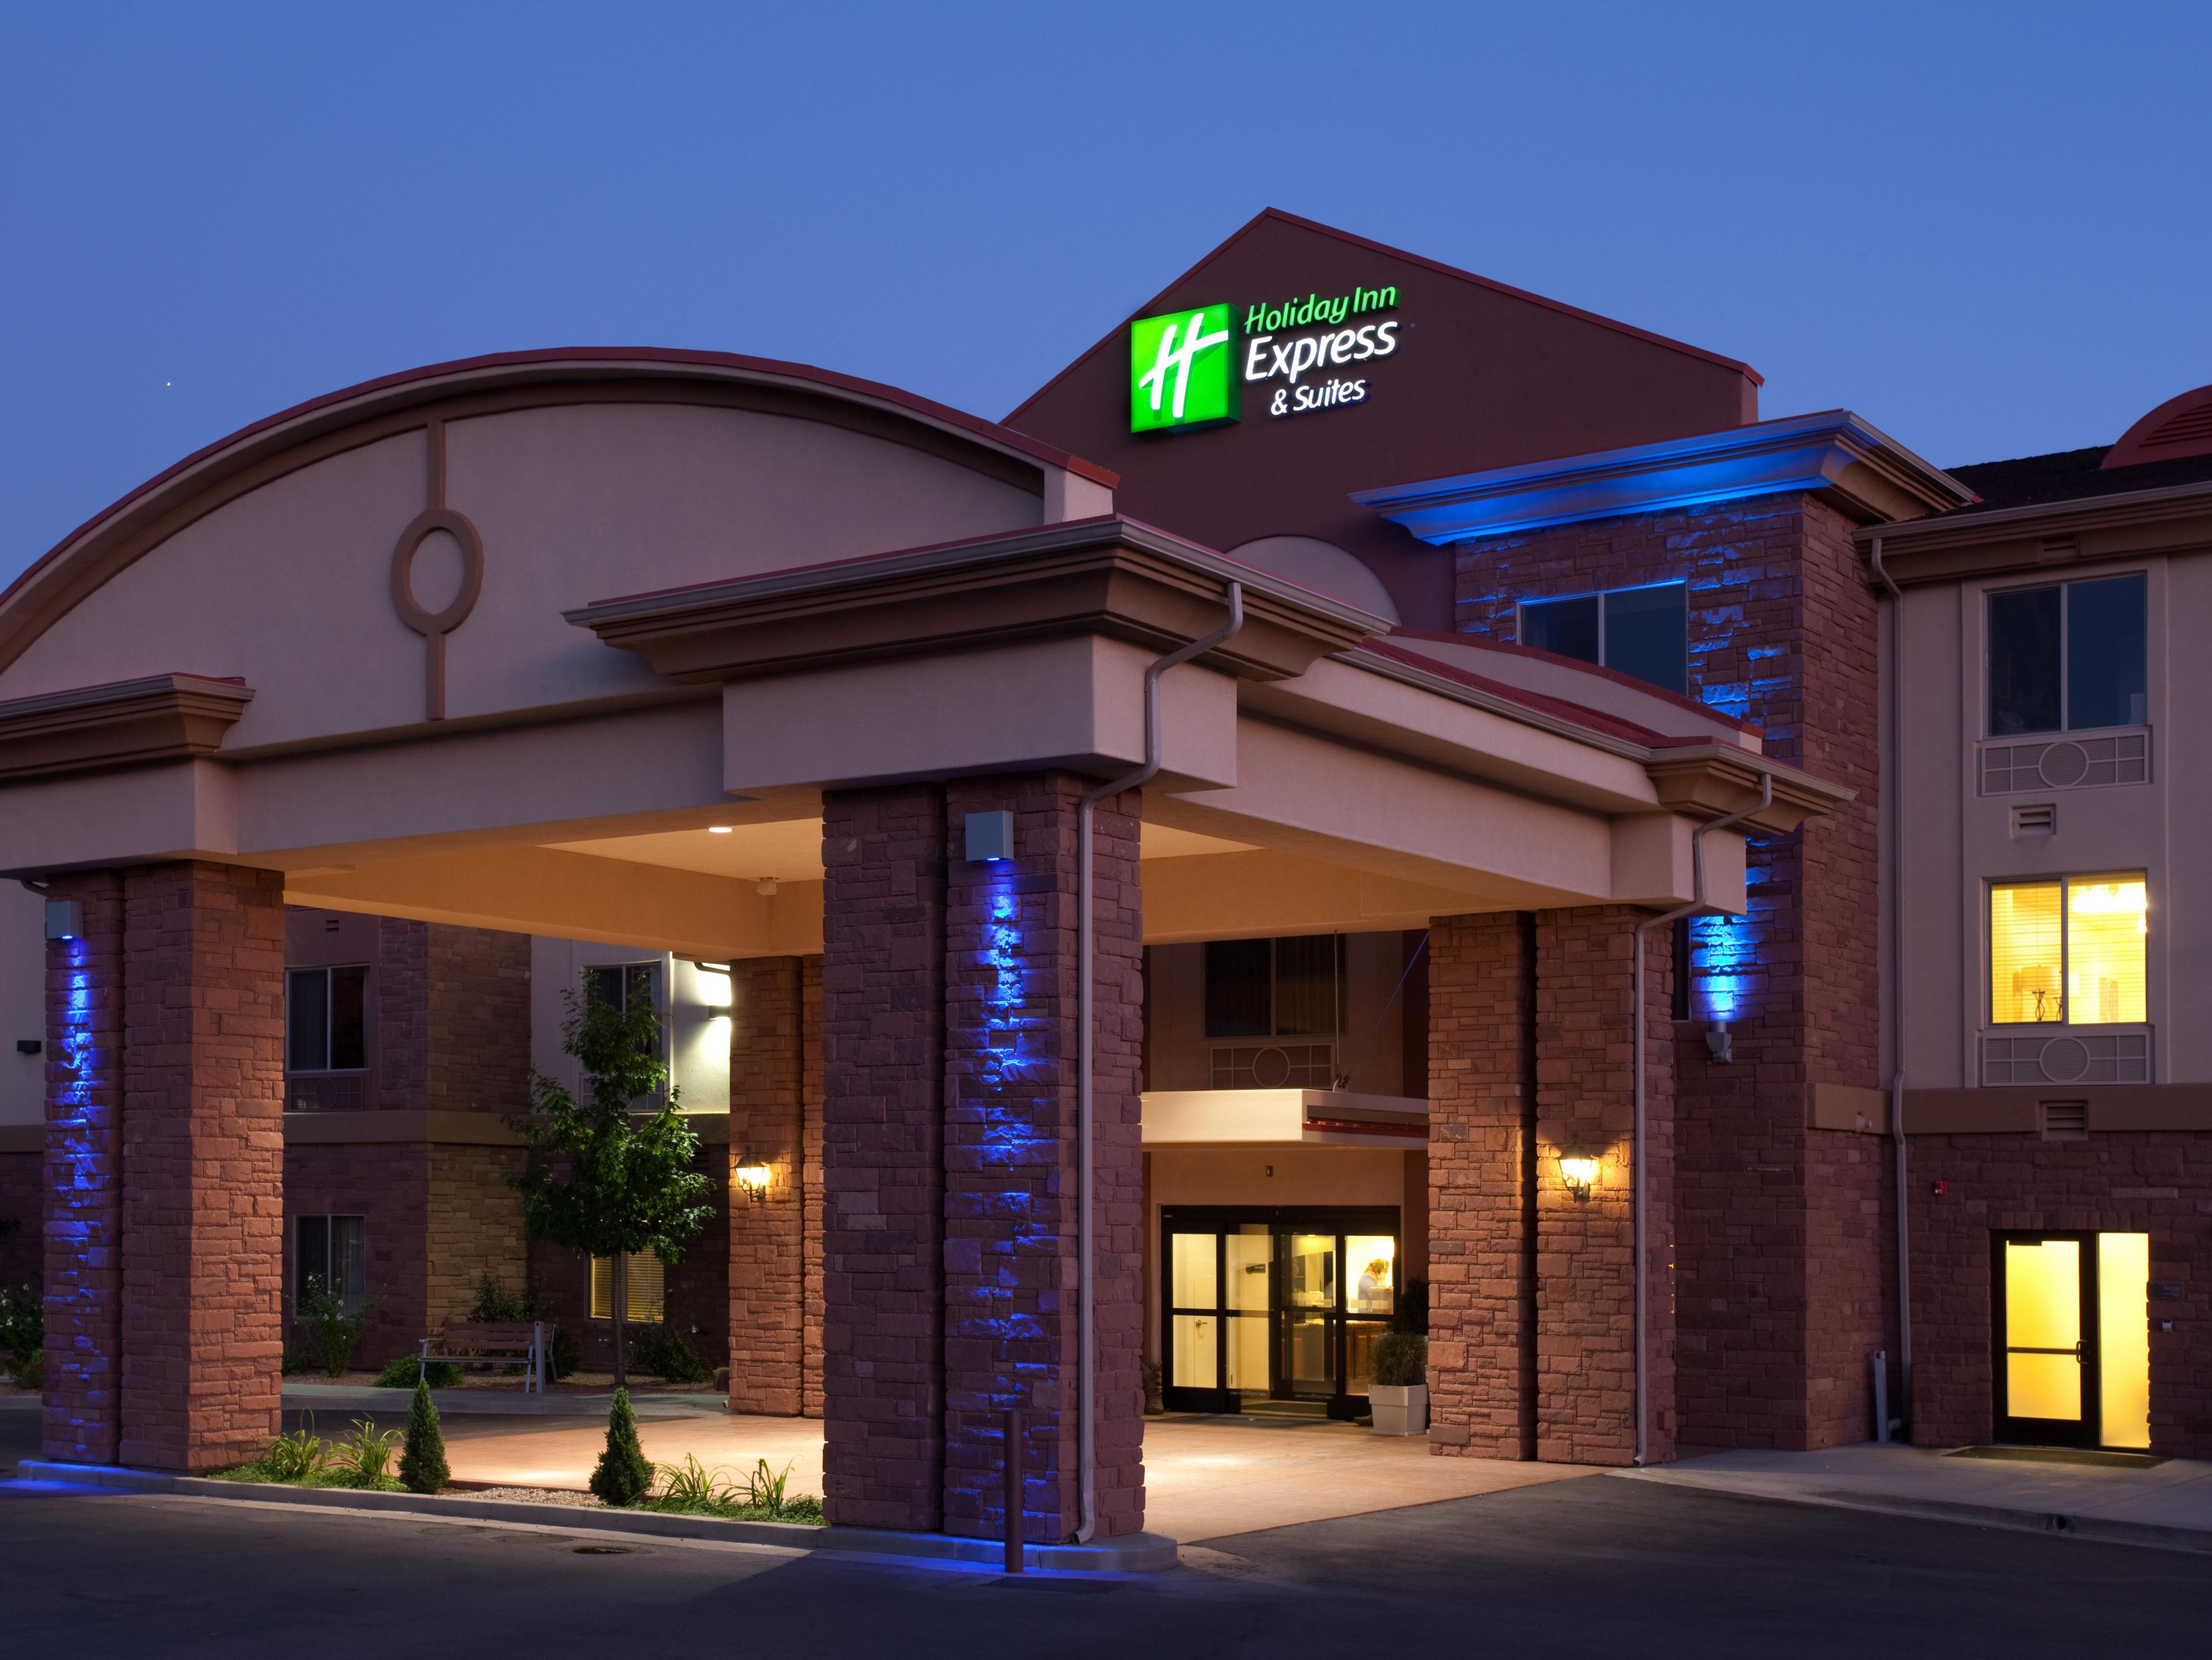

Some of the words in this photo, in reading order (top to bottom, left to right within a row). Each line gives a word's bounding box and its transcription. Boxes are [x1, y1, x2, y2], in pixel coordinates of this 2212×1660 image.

[1244, 293, 1349, 334] Holiday
[1353, 286, 1397, 313] Inn
[1245, 321, 1399, 384] Express
[1271, 389, 1288, 416] &
[1293, 379, 1366, 412] Suites
